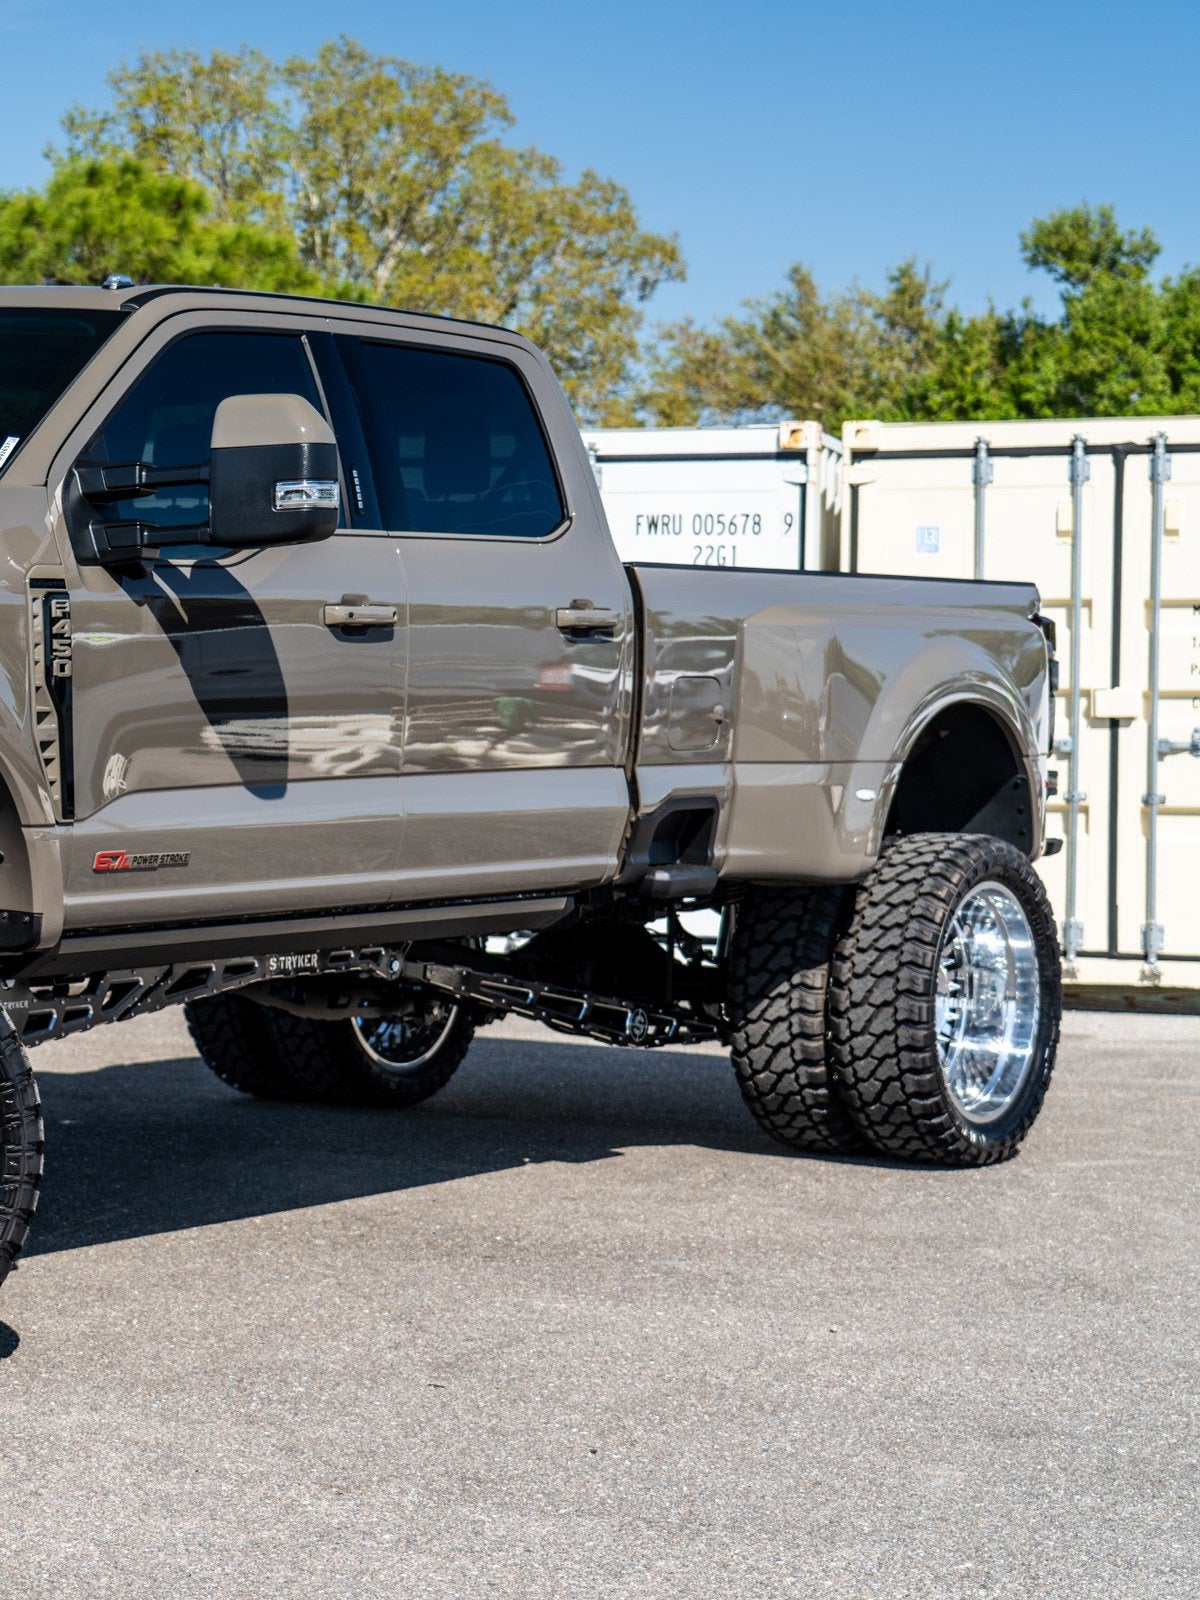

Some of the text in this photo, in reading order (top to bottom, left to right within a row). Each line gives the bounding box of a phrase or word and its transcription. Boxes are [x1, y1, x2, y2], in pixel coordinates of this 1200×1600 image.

[635, 512, 794, 536] FWRU 005678 9
[692, 545, 737, 567] 22G1
[50, 598, 73, 678] F450
[132, 854, 159, 866] POWER
[159, 853, 191, 864] STROKE
[269, 953, 319, 971] STRYKER
[0, 1000, 29, 1010] TRYKER
